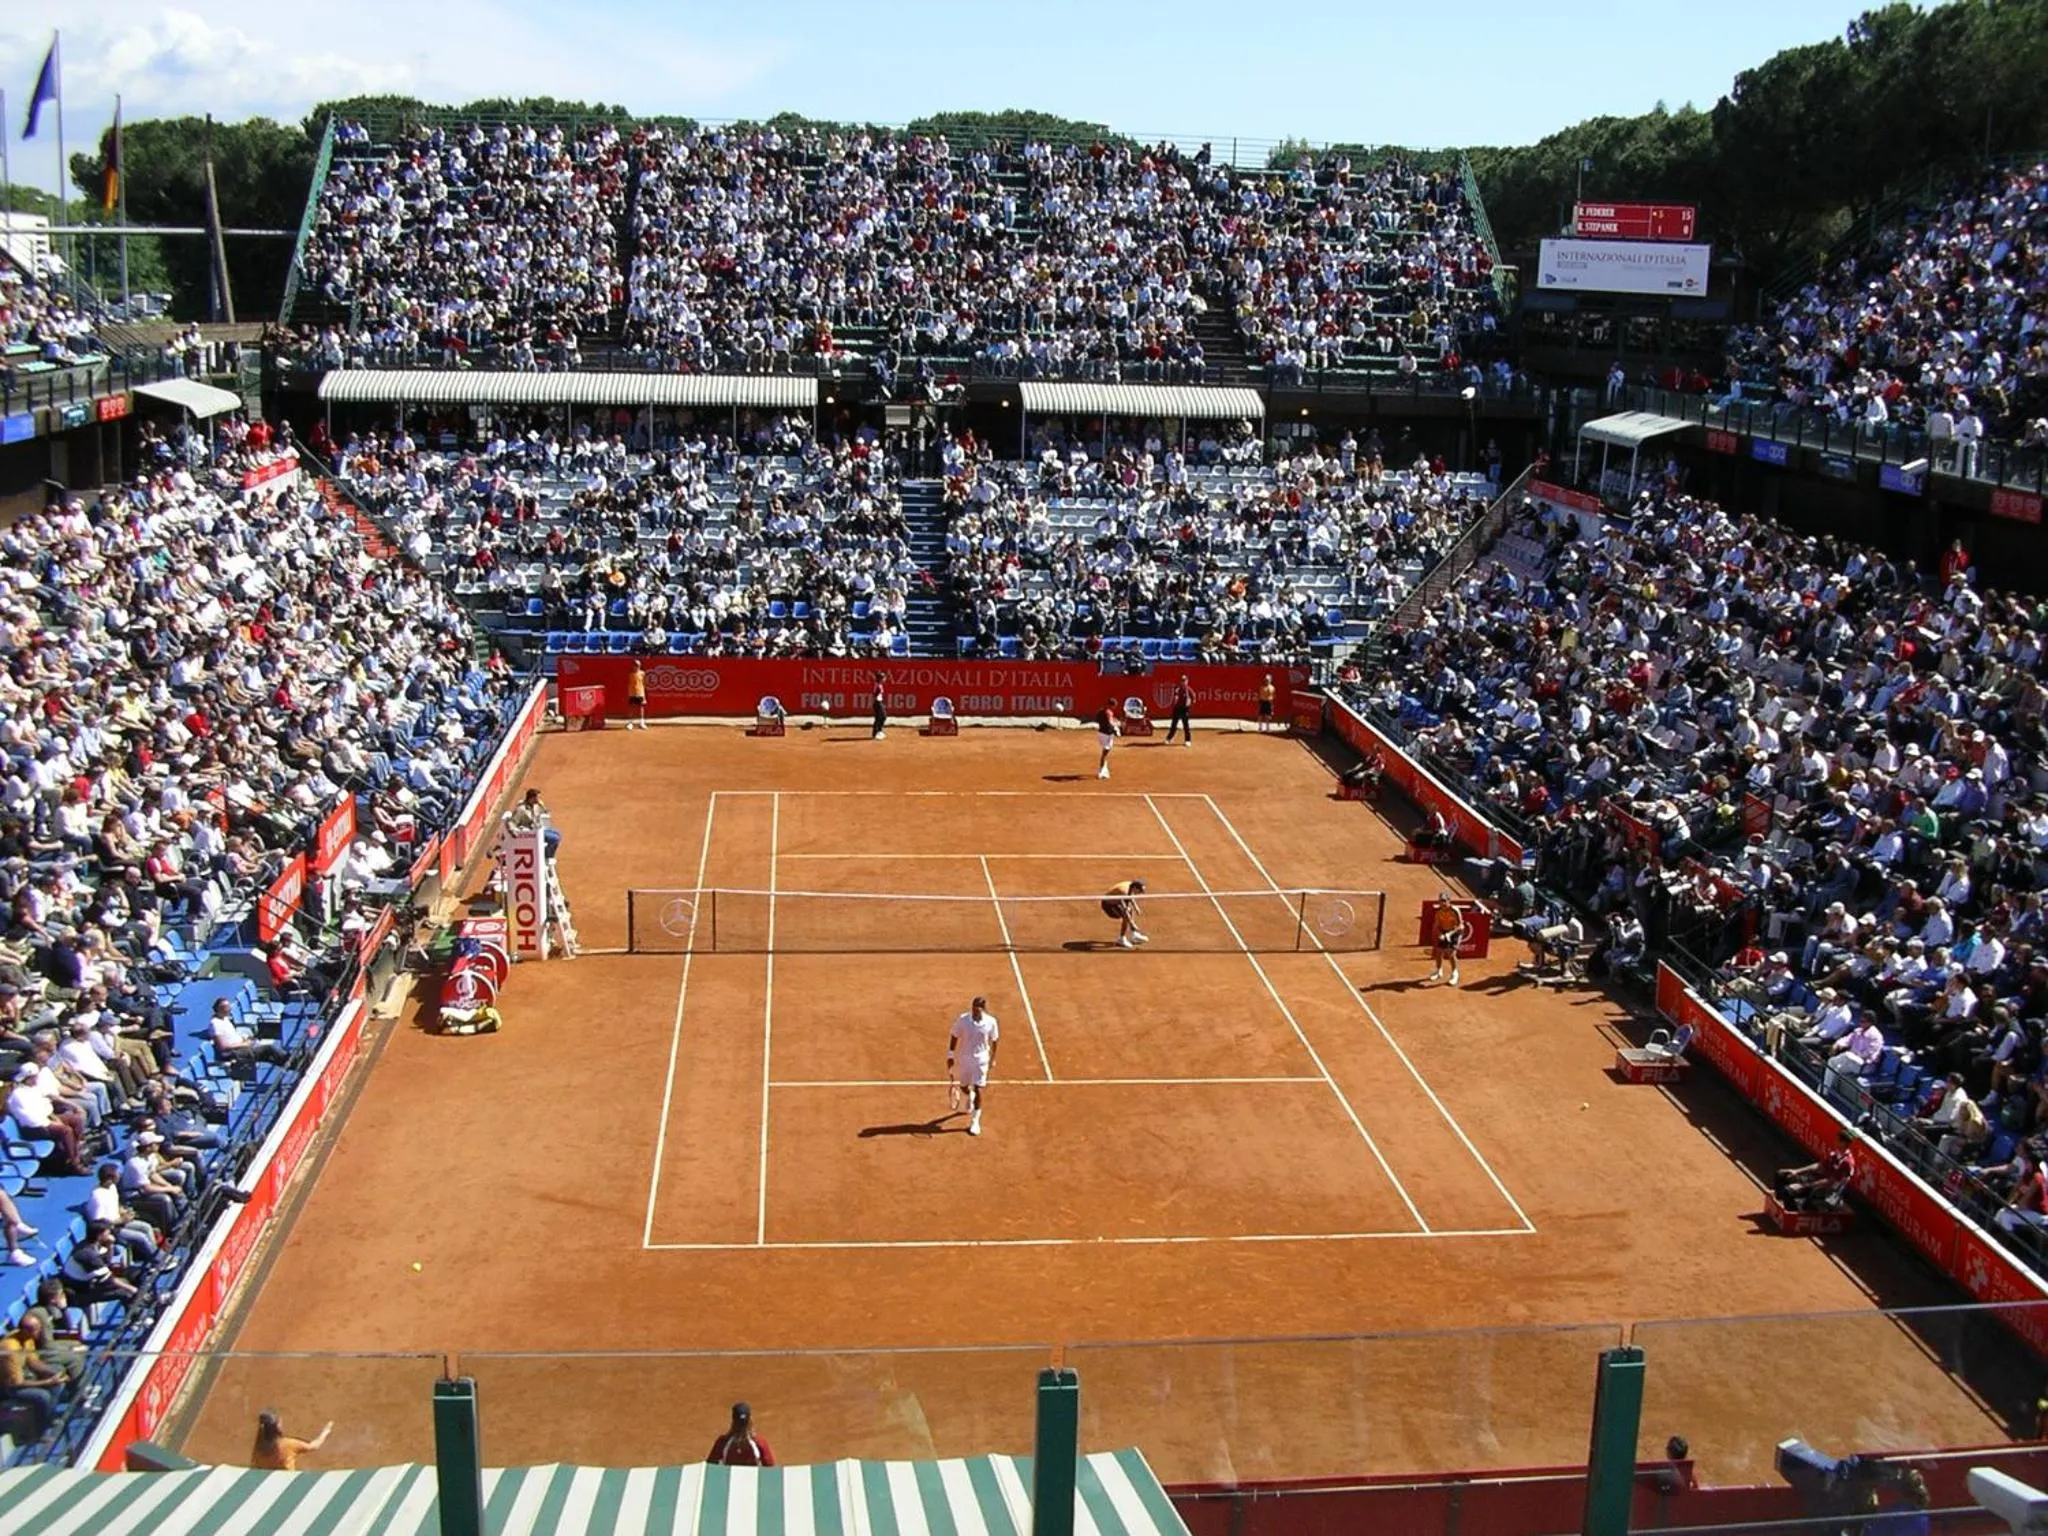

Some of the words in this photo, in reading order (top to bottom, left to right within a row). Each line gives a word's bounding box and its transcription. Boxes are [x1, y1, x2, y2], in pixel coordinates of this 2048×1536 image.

[1682, 210, 1691, 220] 15
[1557, 250, 1640, 264] INTERNAZIONALI
[802, 667, 980, 687] INTERNAZIONALI
[990, 670, 1073, 688] D'ITALIA
[801, 692, 845, 709] FORO
[960, 695, 1004, 711] FORO
[514, 848, 536, 951] RICOH
[1642, 1067, 1680, 1083] FILA
[1796, 1216, 1842, 1233] FILA
[1876, 1189, 1943, 1260] FIDEURAM
